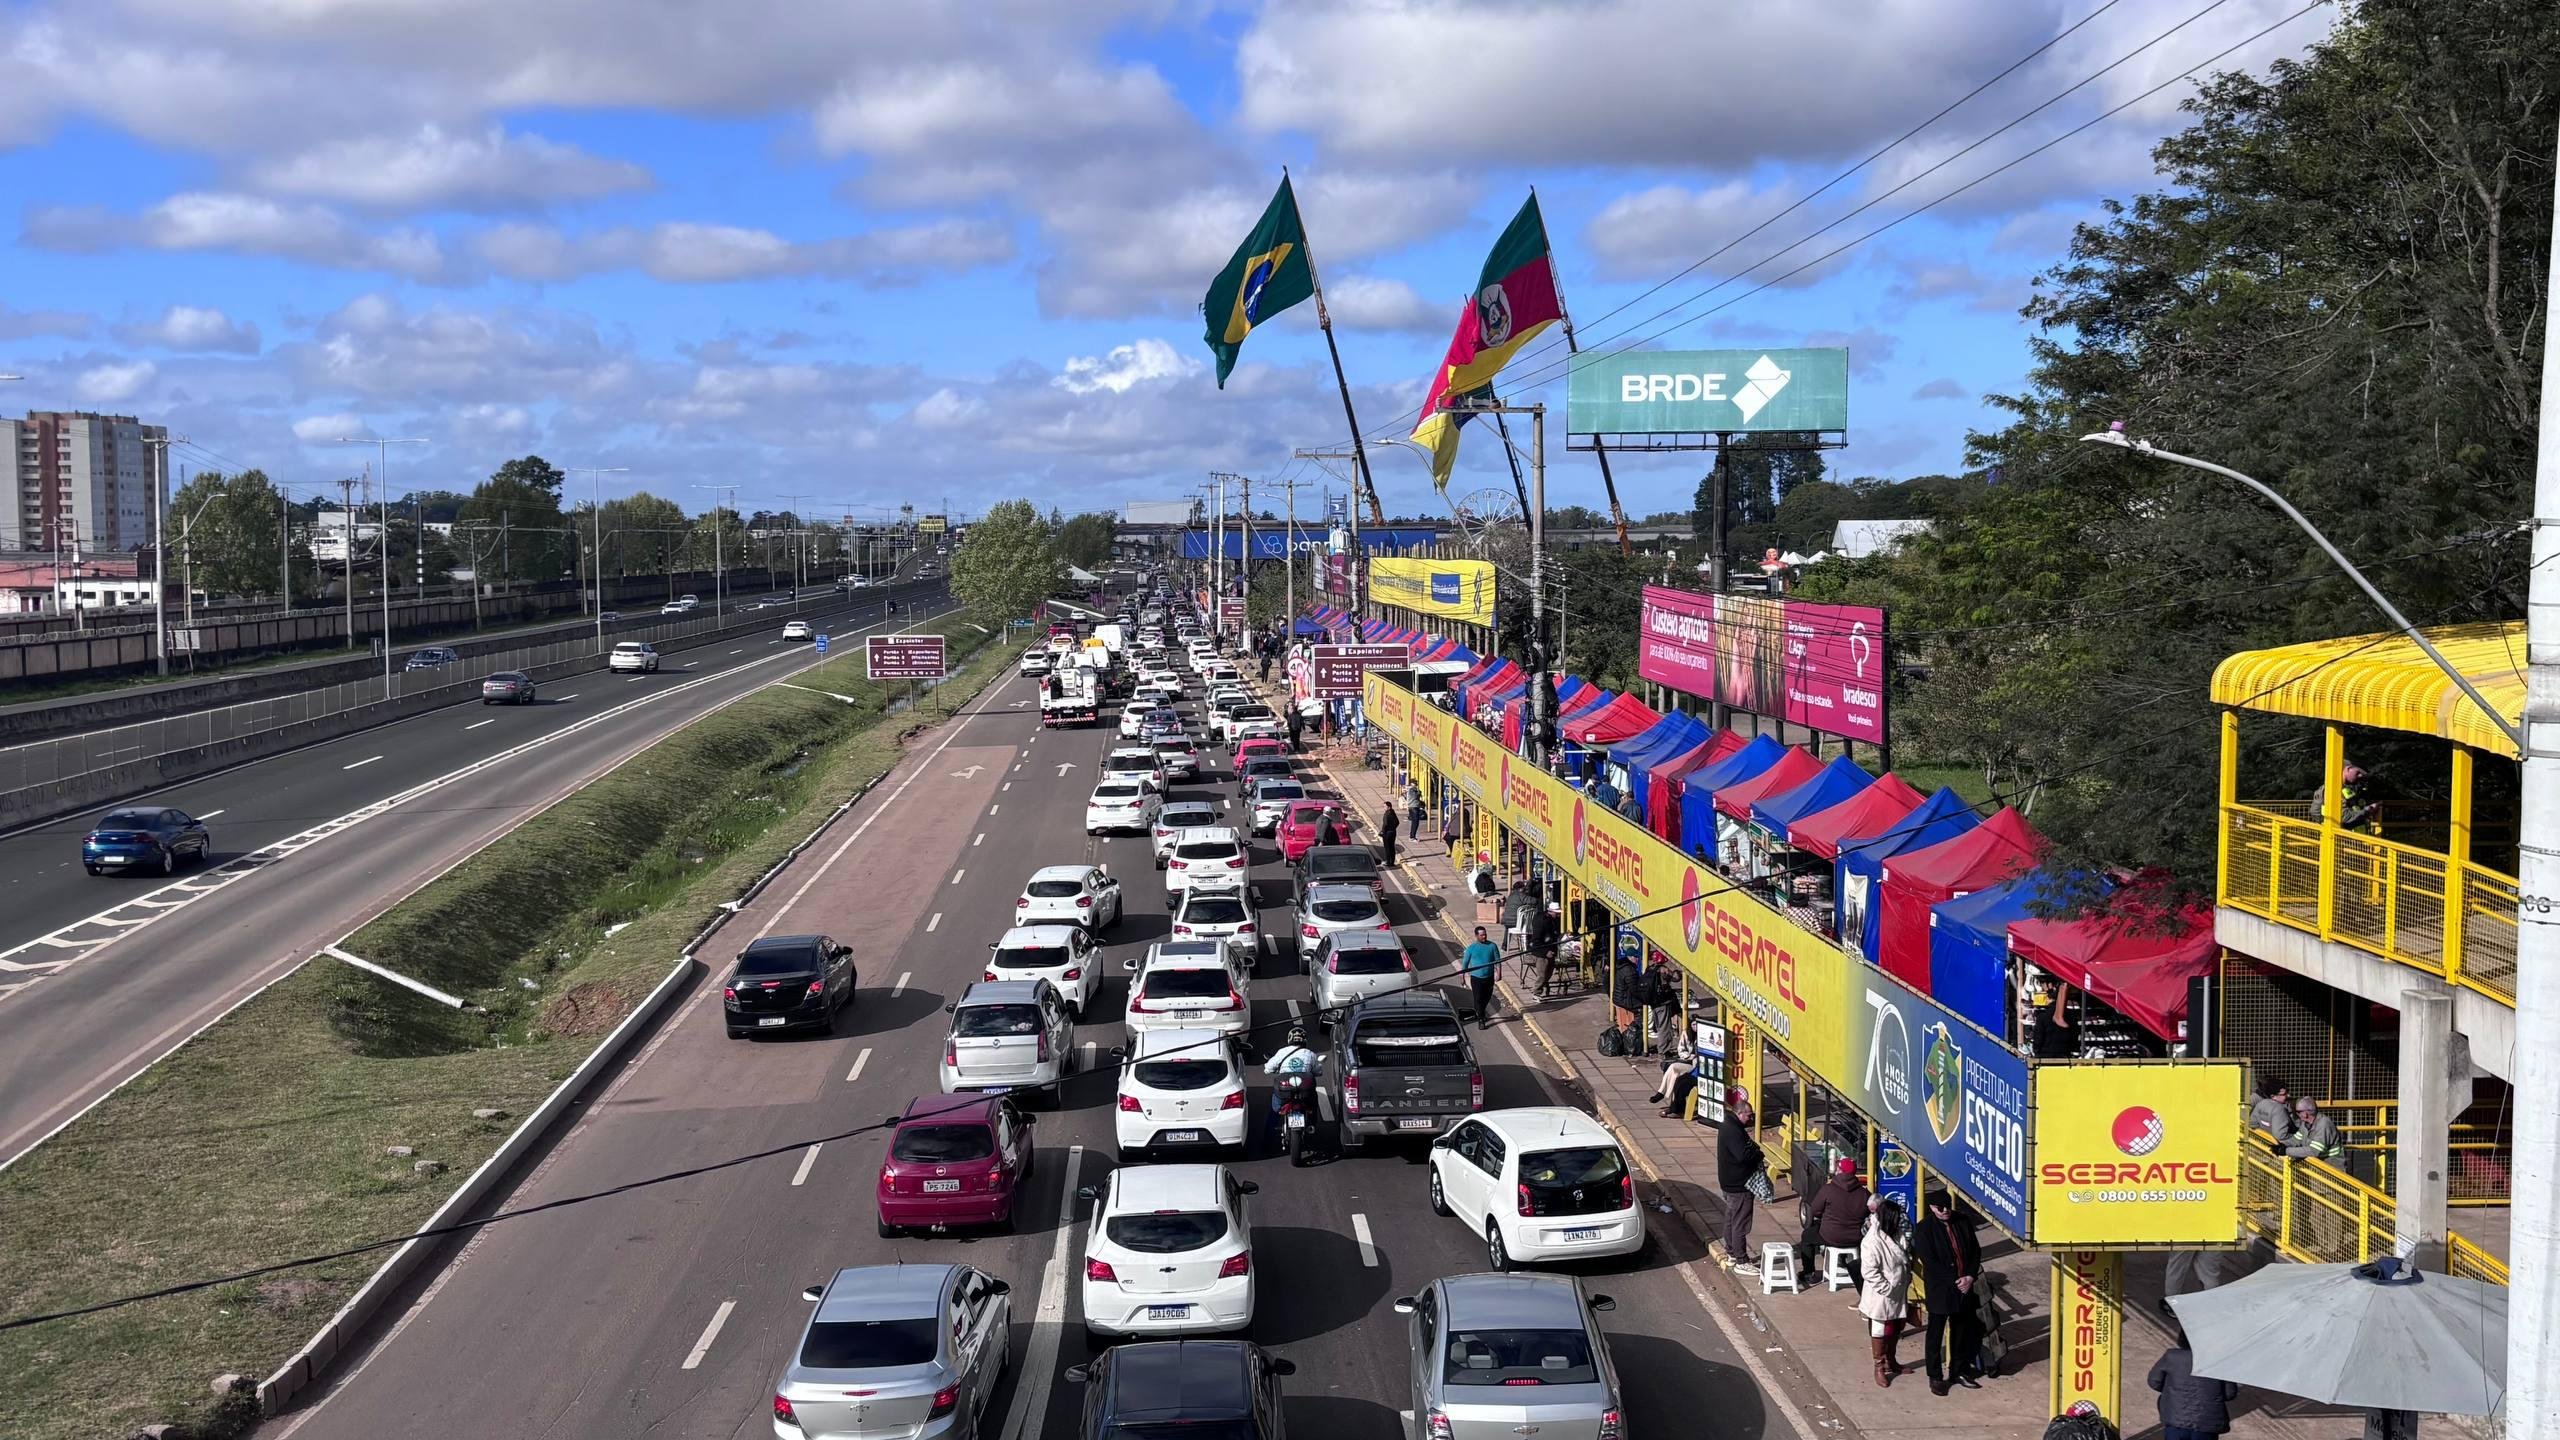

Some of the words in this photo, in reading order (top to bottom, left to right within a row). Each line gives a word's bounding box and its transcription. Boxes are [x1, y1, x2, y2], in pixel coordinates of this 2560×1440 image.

[1621, 373, 1727, 402] BRDE
[1651, 606, 1678, 637] Custeio
[1679, 609, 1709, 647] agrícola
[1347, 648, 1384, 656] Expointer
[1843, 682, 1877, 708] bradesco
[1510, 773, 1552, 828] SEBRATEL
[1587, 823, 1649, 898] SEBRATEL
[1704, 900, 1806, 1012] SEBRATEL
[1730, 973, 1751, 1012] 0800
[1750, 992, 1768, 1025] 655
[1768, 1006, 1791, 1041] 1000
[1732, 1010, 1745, 1079] SEBRA
[1864, 987, 1910, 1115] 70
[1884, 1062, 1905, 1087] ANOS
[1884, 1076, 1909, 1105] ESTEIO
[1965, 1056, 2011, 1110] PREFEITURA
[2011, 1091, 2024, 1121] DE
[1361, 1099, 1468, 1109] RANGER
[1965, 1088, 2023, 1183] ESTEIO
[1965, 1150, 1986, 1178] Cidade
[1986, 1167, 1996, 1184] do
[1995, 1174, 2022, 1205] trabalho
[1970, 1173, 1976, 1184] e
[1975, 1174, 1985, 1190] do
[1984, 1184, 2017, 1217] progresso
[2041, 1162, 2233, 1185] SEBRATEL
[2098, 1189, 2137, 1202] 0800
[2140, 1189, 2167, 1202] 655
[2169, 1189, 2207, 1202] 1000
[2074, 1251, 2096, 1392] SEBRATE
